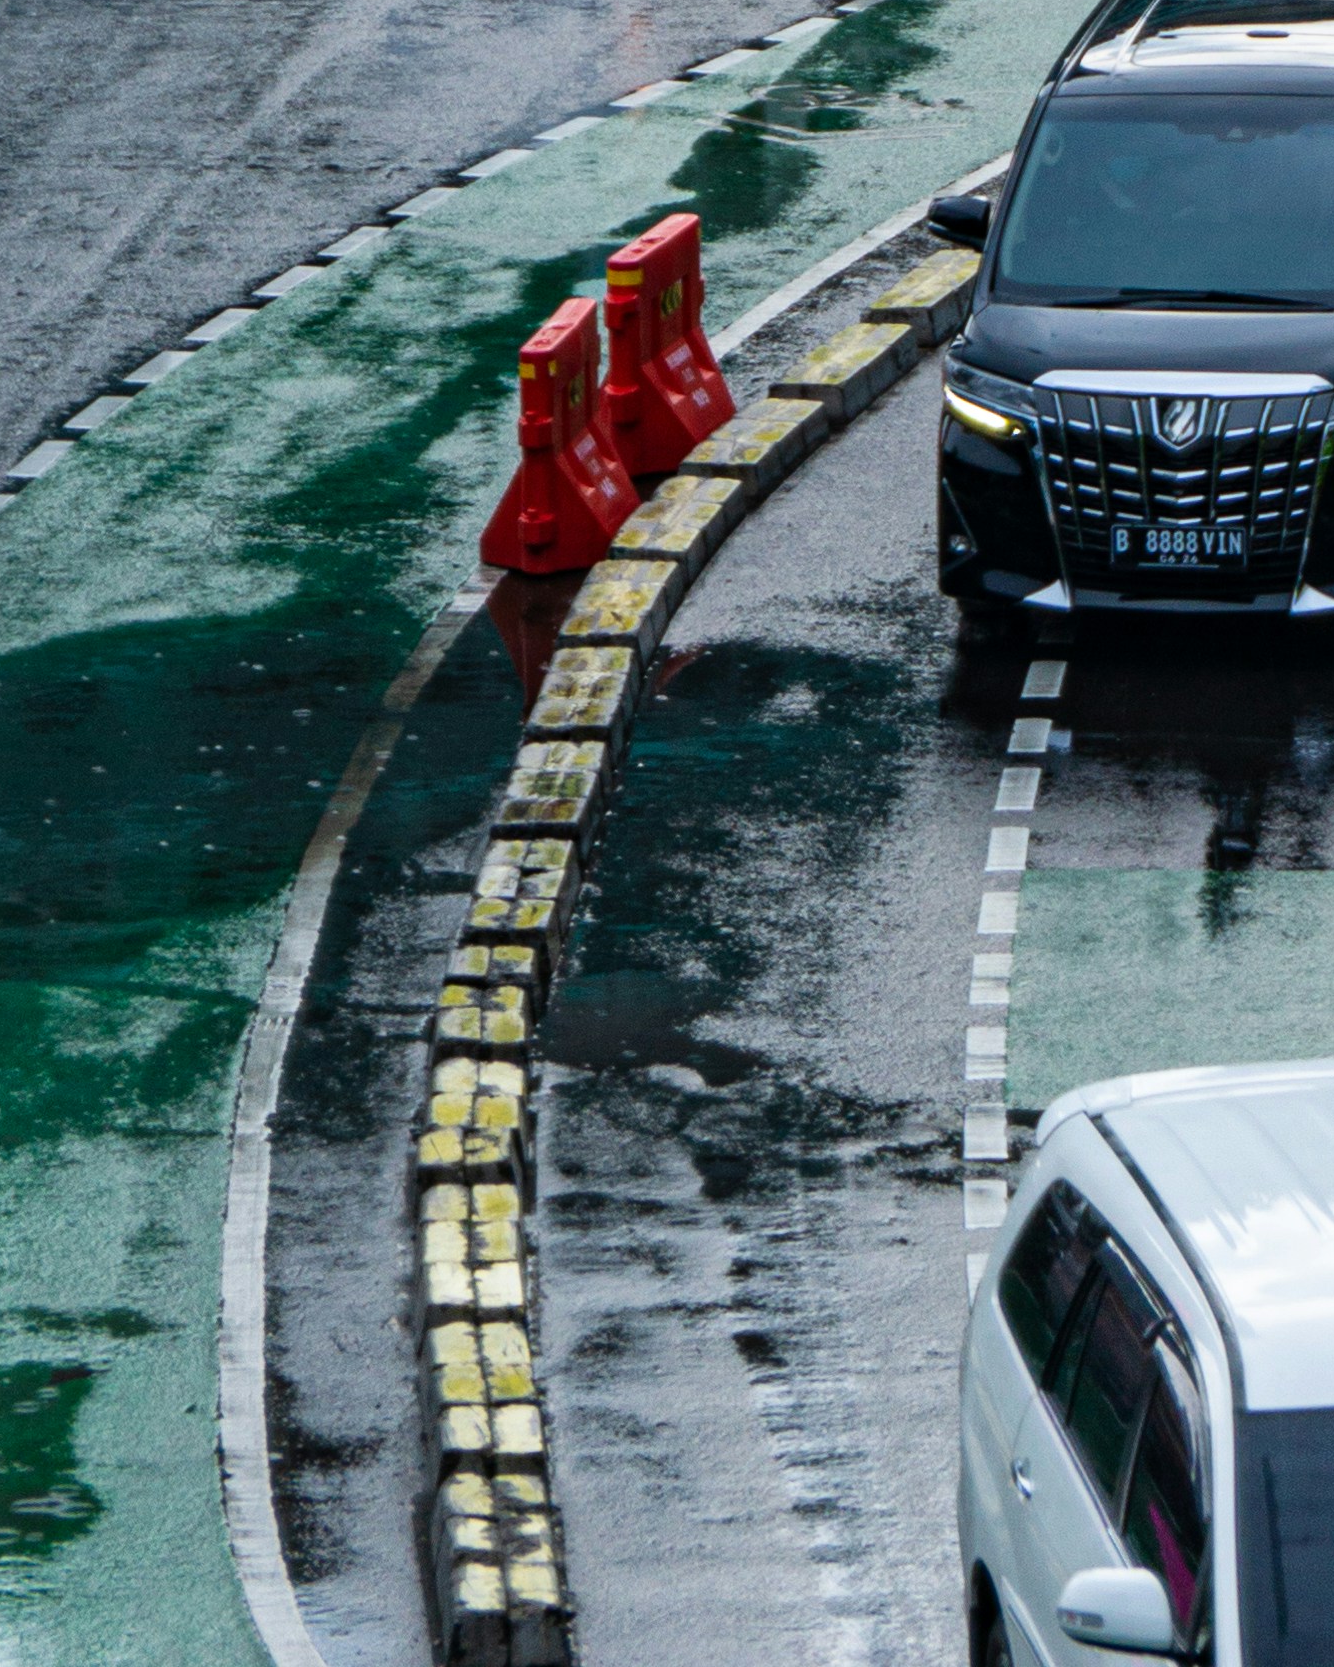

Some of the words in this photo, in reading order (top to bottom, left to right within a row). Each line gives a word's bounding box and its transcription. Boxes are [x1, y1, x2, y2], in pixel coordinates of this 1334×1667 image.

[1115, 529, 1129, 553] B
[1146, 529, 1198, 554] 8888
[1202, 531, 1242, 555] VIN
